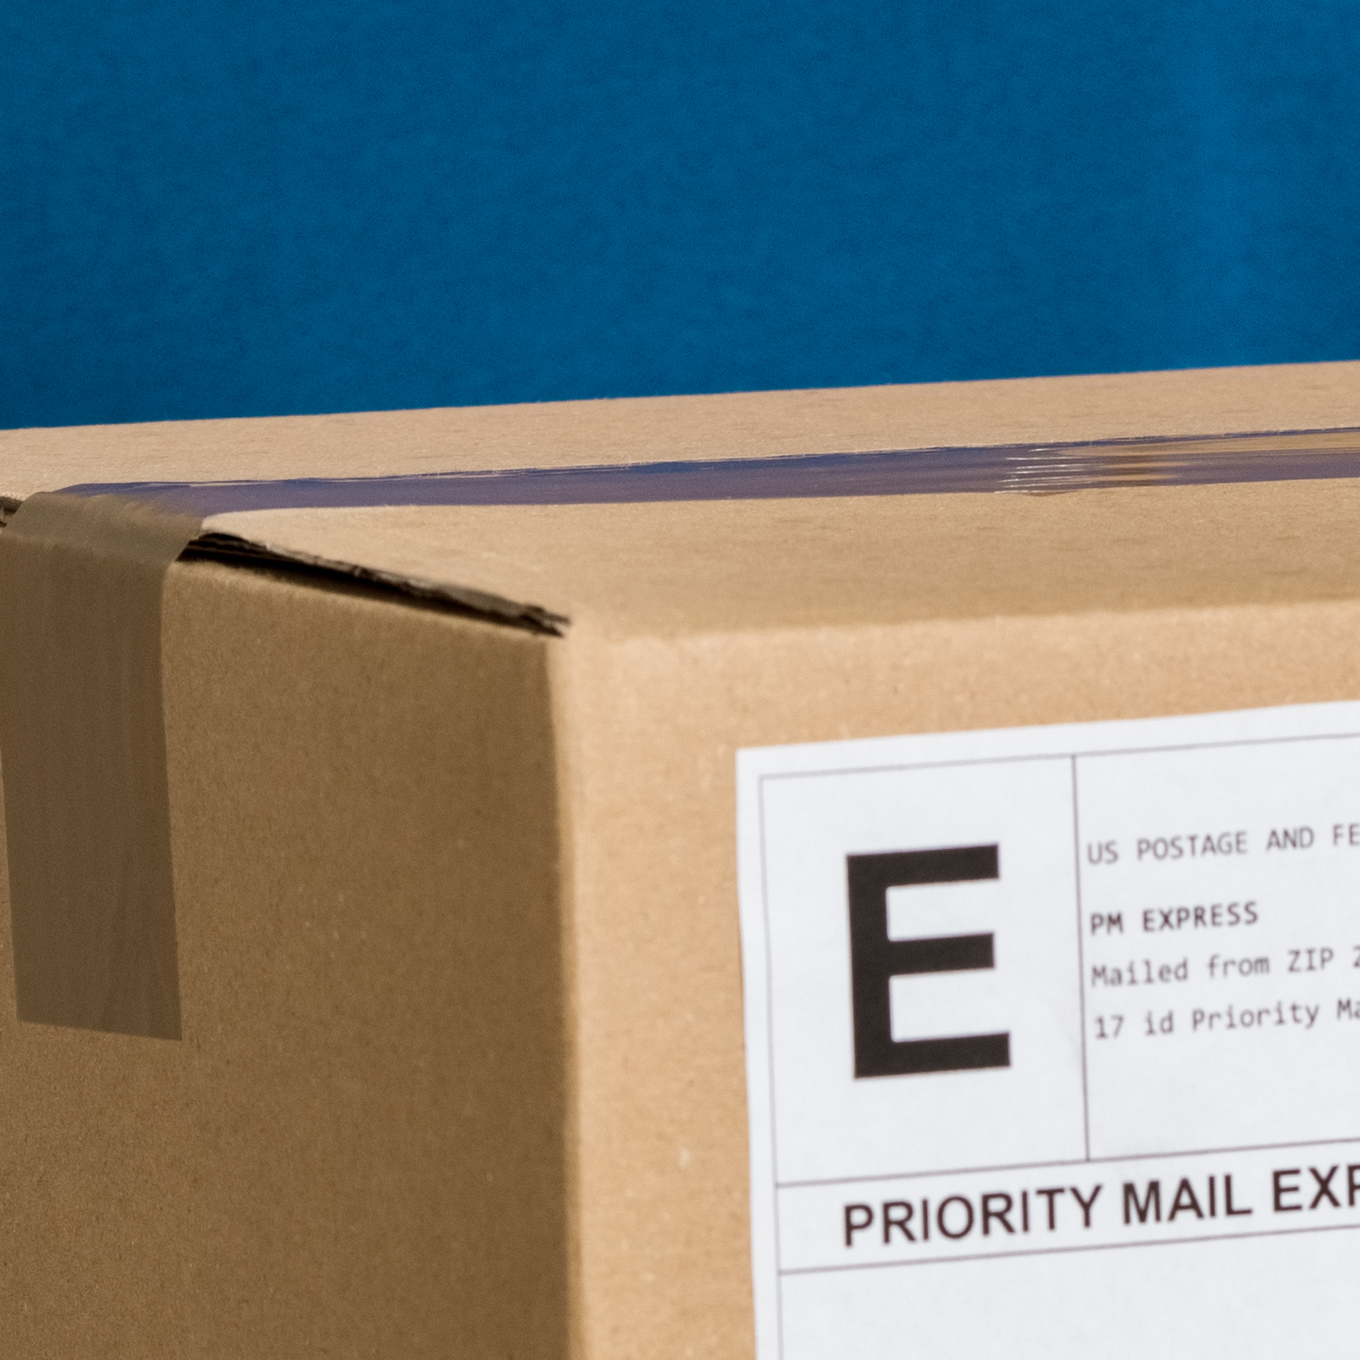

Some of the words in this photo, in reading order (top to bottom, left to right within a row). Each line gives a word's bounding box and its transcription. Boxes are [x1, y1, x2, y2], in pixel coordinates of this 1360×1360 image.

[1086, 839, 1120, 866] US
[1137, 831, 1246, 860] POSTAGE
[1266, 826, 1315, 850] AND
[1090, 912, 1124, 935] PM
[1142, 901, 1258, 932] EXPRESS
[845, 842, 1012, 1080] E
[1091, 958, 1189, 987] Mailed
[1207, 954, 1270, 977] from
[1288, 947, 1334, 973] ZIP
[1095, 1014, 1124, 1040] 17
[1145, 1010, 1174, 1036] id
[1192, 1001, 1319, 1031] Priority
[843, 1184, 1103, 1248] PRIORITY
[1122, 1173, 1253, 1226] MAIL
